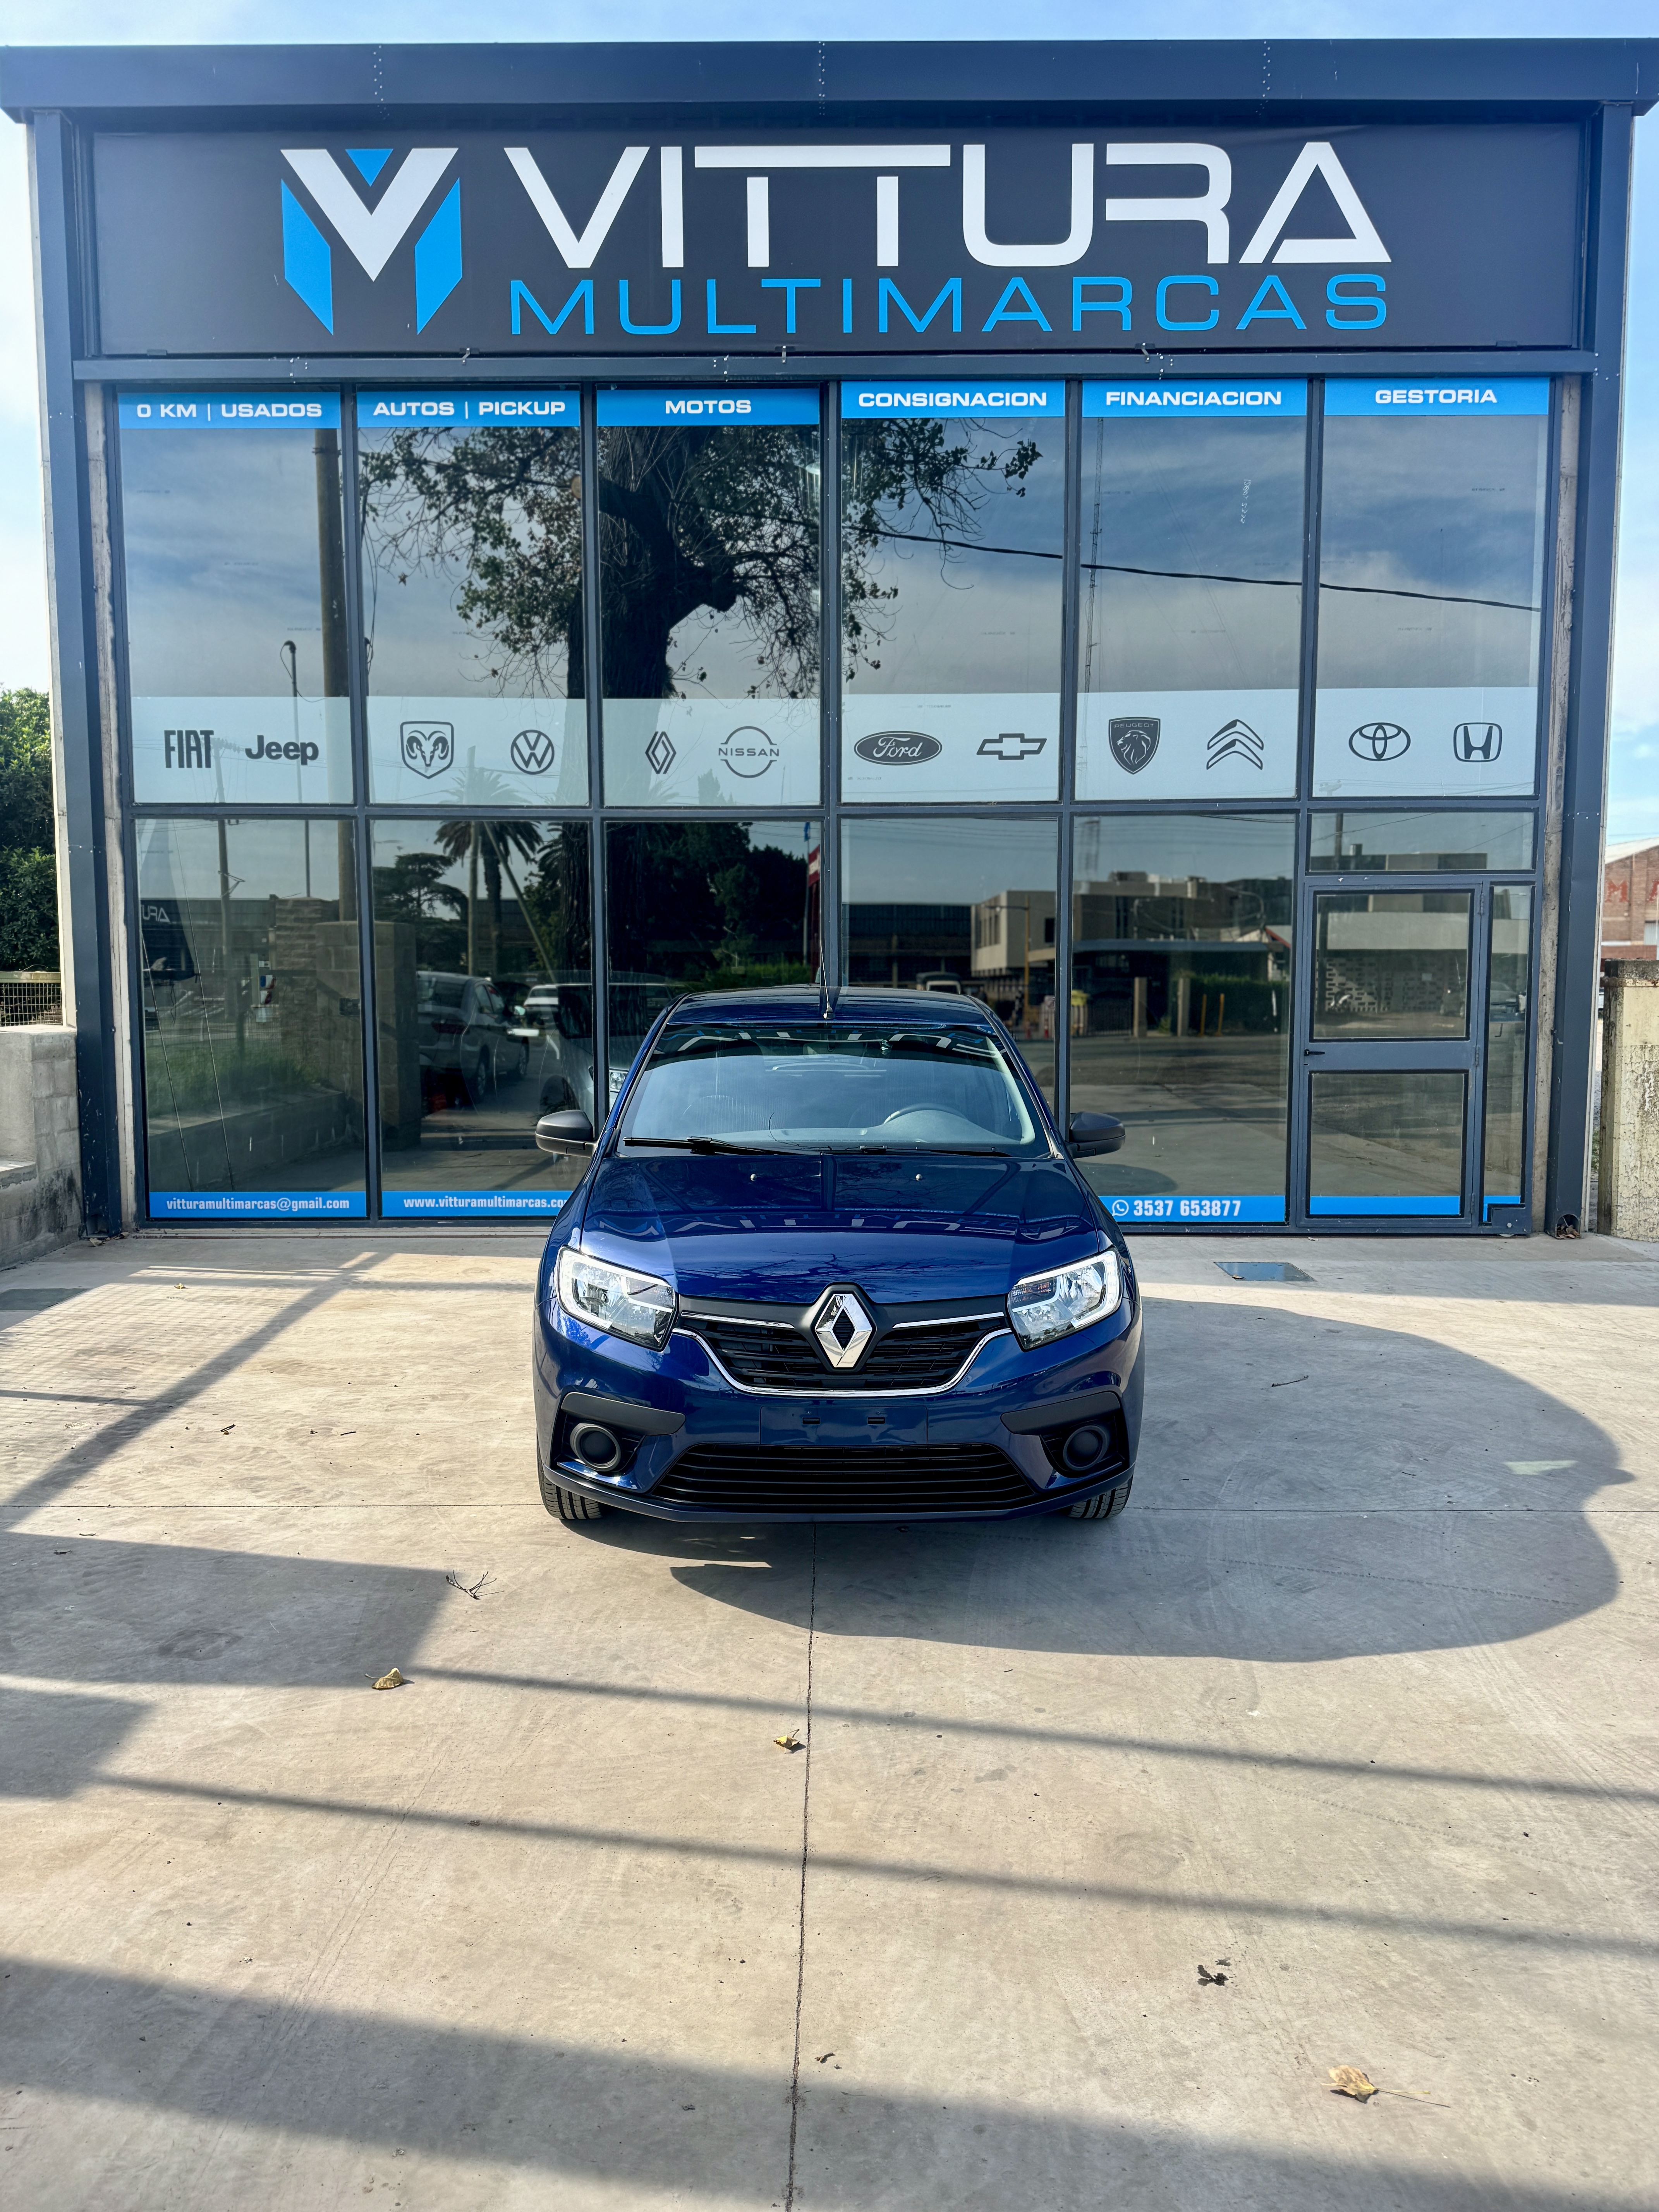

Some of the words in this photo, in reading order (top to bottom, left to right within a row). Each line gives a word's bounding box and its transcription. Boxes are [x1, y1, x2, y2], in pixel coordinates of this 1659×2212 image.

[504, 142, 1391, 268] VITTURA
[510, 274, 1387, 335] MULTIMARCAS
[859, 392, 1046, 407] CONSIGNACION
[1106, 392, 1281, 405] FINANCIACION
[1375, 389, 1497, 404] GESTORIA
[137, 406, 151, 418] 0
[160, 406, 197, 418] KM
[221, 405, 322, 418] USADOS
[373, 403, 454, 416] AUTOS
[479, 402, 565, 415] PICKUP
[666, 400, 751, 414] MOTOS
[164, 730, 214, 768] FIAT
[245, 735, 319, 765] Jeep
[718, 748, 779, 757] NISSAN
[873, 737, 923, 757] Ford
[141, 905, 170, 922] URA
[167, 1197, 349, 1211] vitturamultimarcas@gmail.com
[404, 1196, 567, 1208] www.vitturamultimarcas.co
[1133, 1200, 1173, 1216] 3537
[1180, 1200, 1241, 1216] 653877
